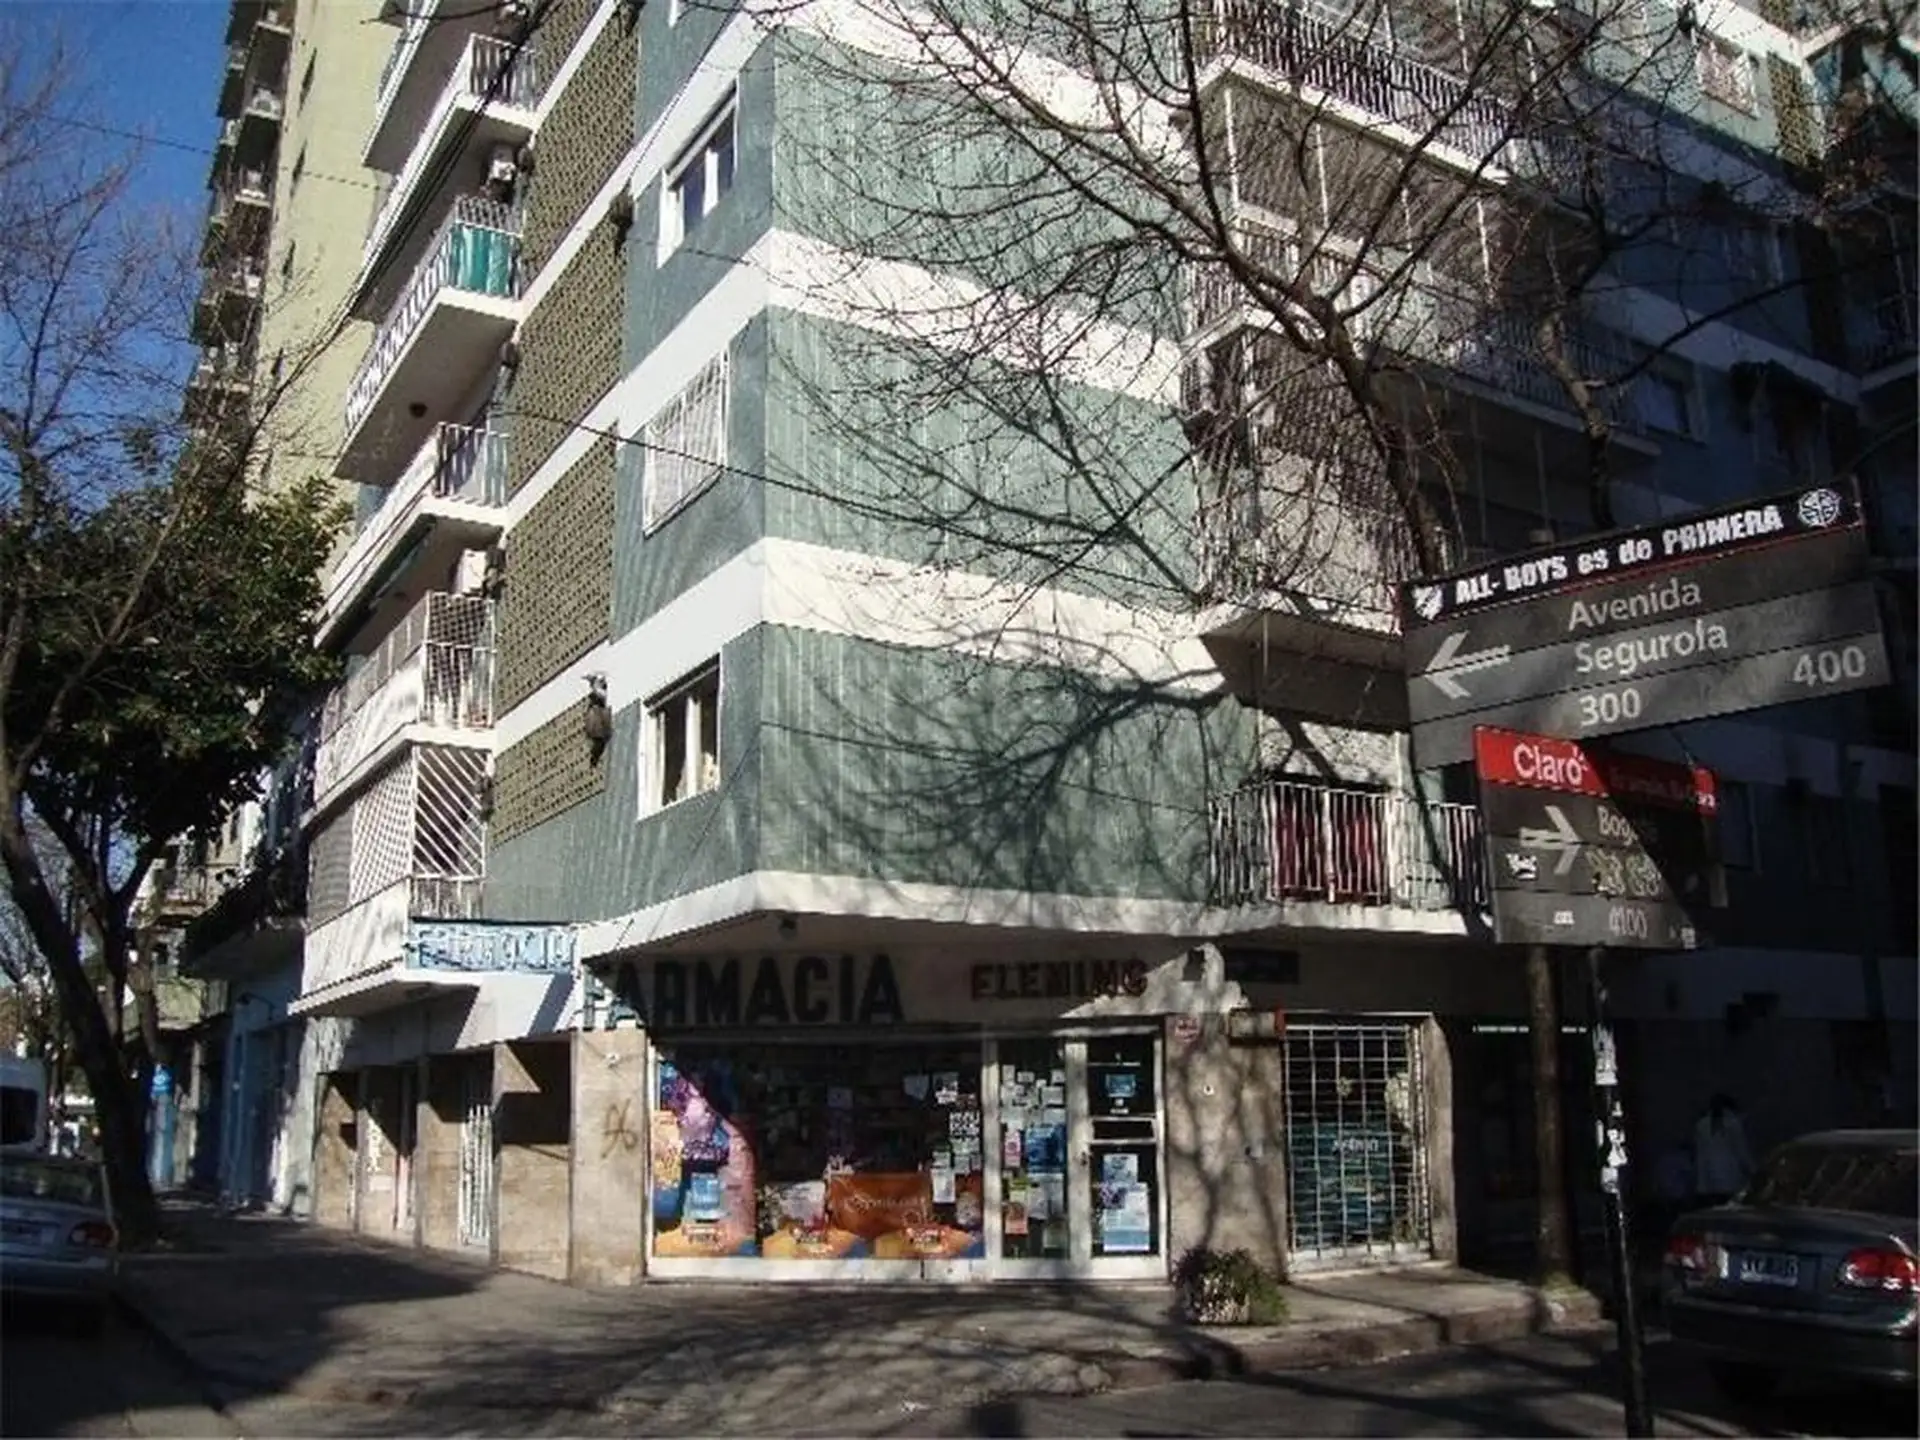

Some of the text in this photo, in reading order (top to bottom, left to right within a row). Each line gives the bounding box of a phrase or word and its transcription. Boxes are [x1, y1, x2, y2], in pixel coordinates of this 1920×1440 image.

[1577, 549, 1609, 574] es
[1619, 539, 1652, 565] de
[1662, 505, 1783, 555] PRIMERA
[1568, 577, 1702, 632] Avenida
[1575, 619, 1729, 674] Segurola
[1579, 645, 1866, 728] 300 400
[1512, 743, 1586, 786] Claro
[1608, 904, 1649, 940] 4100
[584, 952, 906, 1031] FARMACIA
